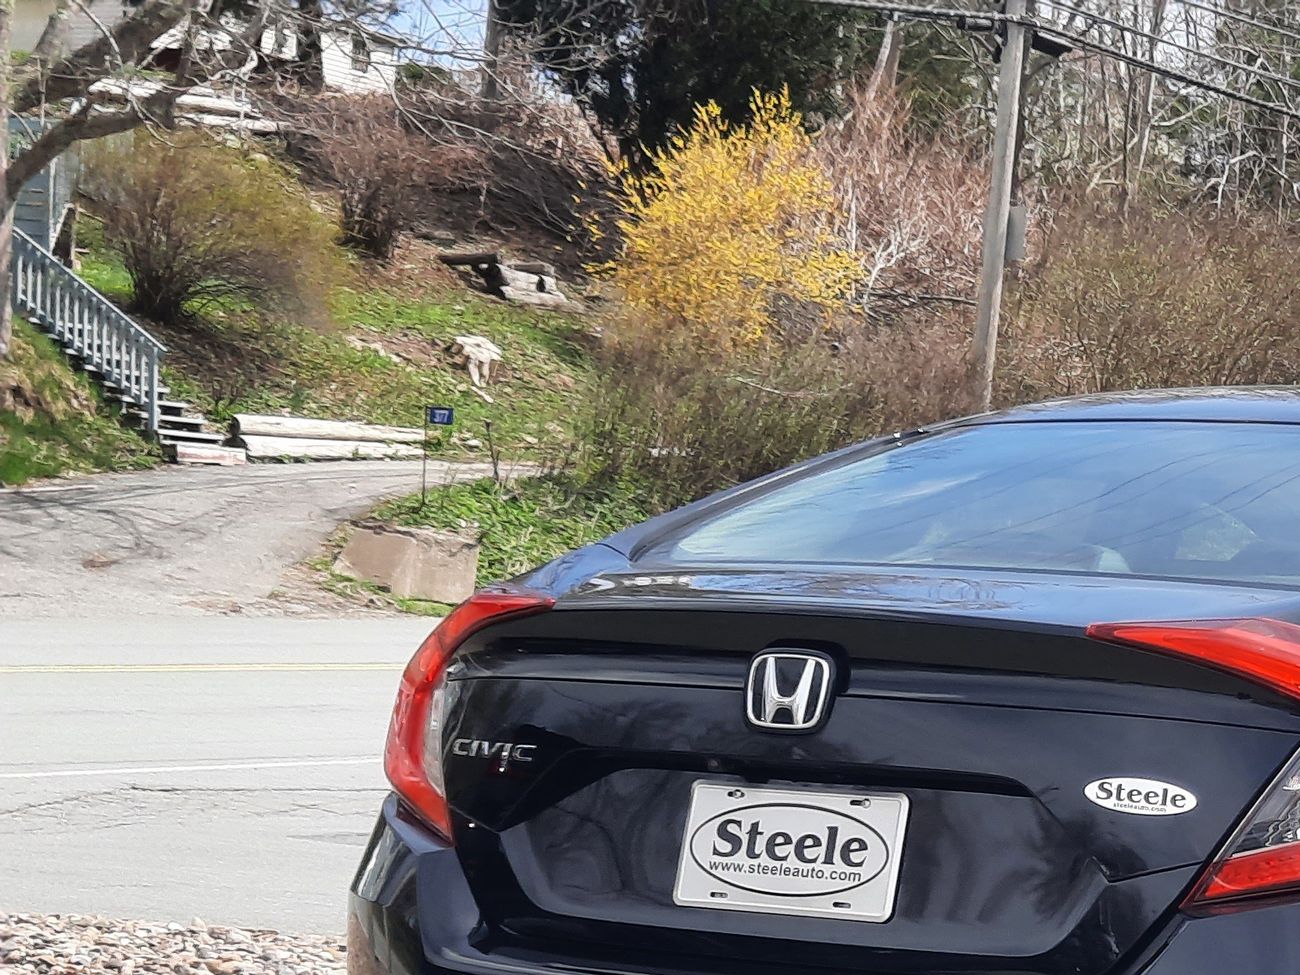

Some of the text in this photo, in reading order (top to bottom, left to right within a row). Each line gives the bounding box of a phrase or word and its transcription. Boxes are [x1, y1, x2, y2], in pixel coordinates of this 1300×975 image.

[1095, 781, 1186, 808] Steele
[712, 818, 868, 868] Steele
[708, 859, 862, 882] www.steeleauto.com
